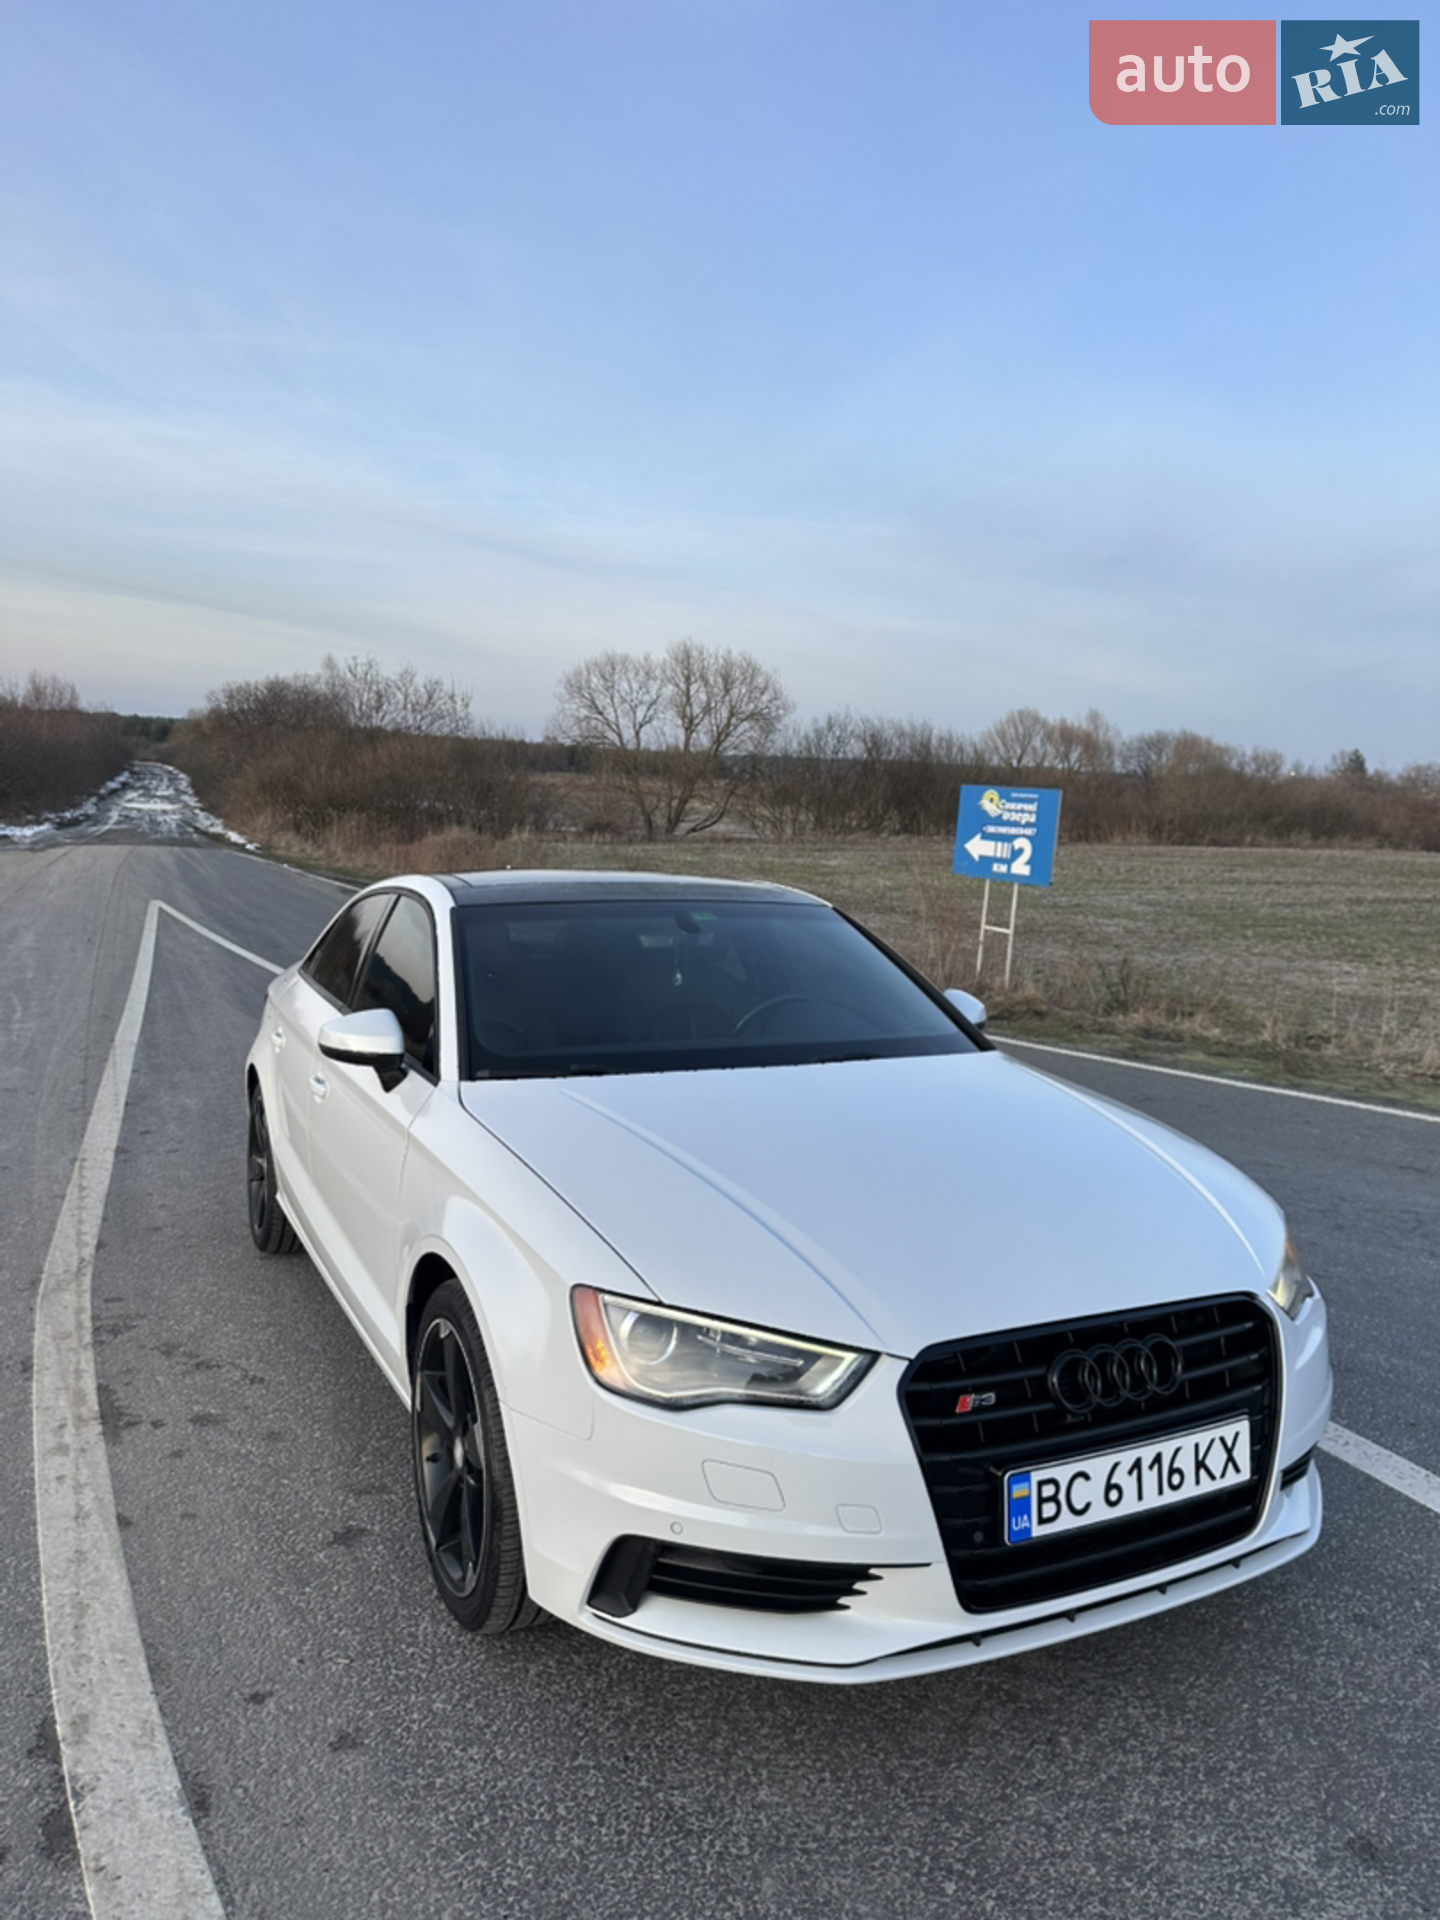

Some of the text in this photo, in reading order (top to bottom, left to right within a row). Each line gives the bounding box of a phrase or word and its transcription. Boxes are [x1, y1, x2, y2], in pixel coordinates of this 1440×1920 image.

[1010, 837, 1032, 876] 2
[1036, 1430, 1241, 1526] BC 6116 KX
[1012, 1516, 1030, 1531] UA
